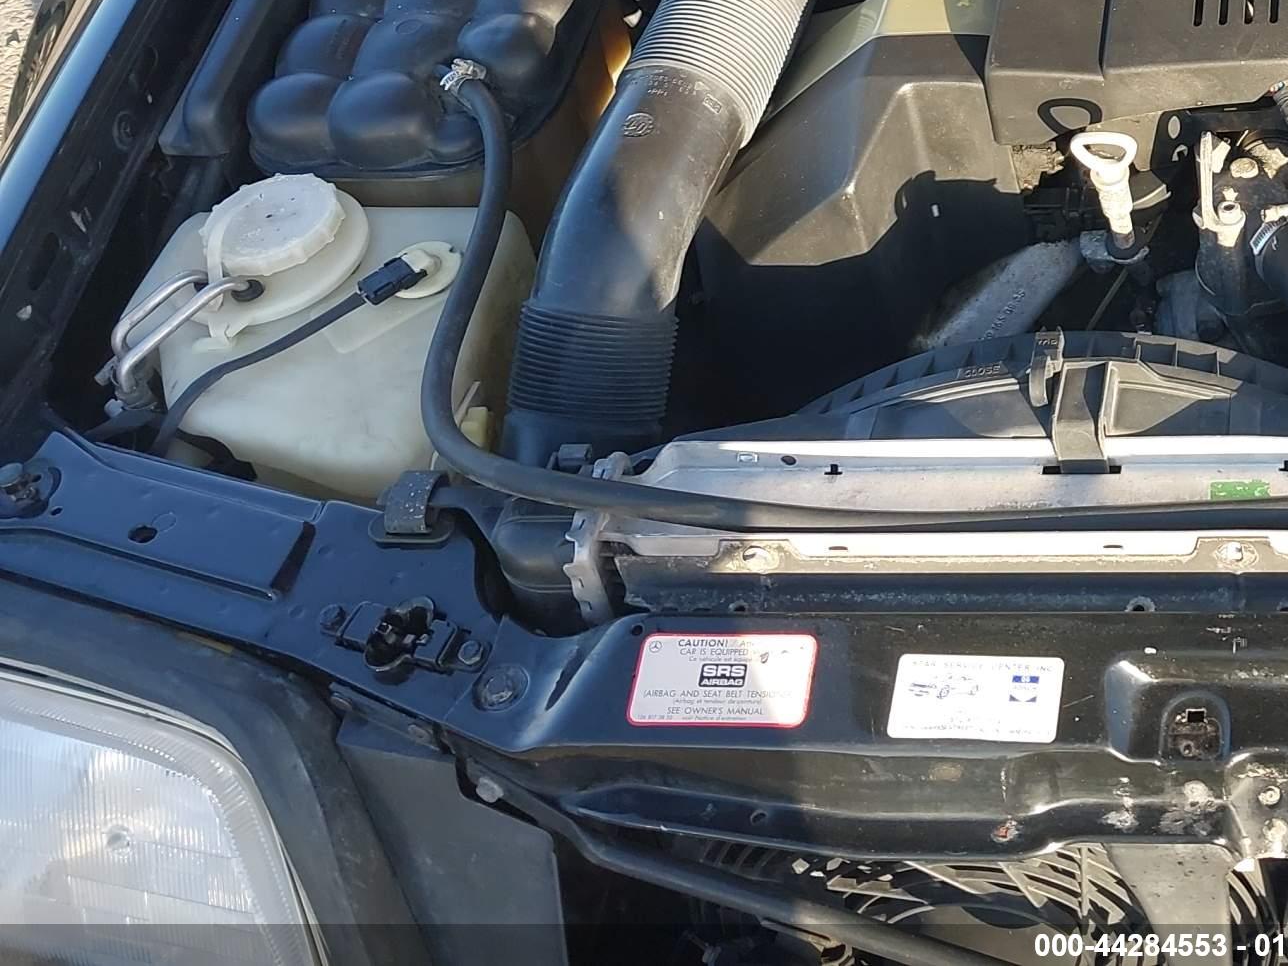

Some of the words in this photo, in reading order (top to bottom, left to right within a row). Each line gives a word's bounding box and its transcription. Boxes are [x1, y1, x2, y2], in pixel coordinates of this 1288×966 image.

[678, 639, 728, 647] CAUTION!
[710, 648, 749, 656] EQUIPPED
[702, 665, 746, 677] SRS
[700, 678, 745, 686] AIRBAG
[679, 690, 699, 698] AND
[702, 690, 721, 698] SEAT
[725, 690, 743, 698] BELT
[667, 707, 681, 715] SEE
[726, 707, 763, 715] MANUAL
